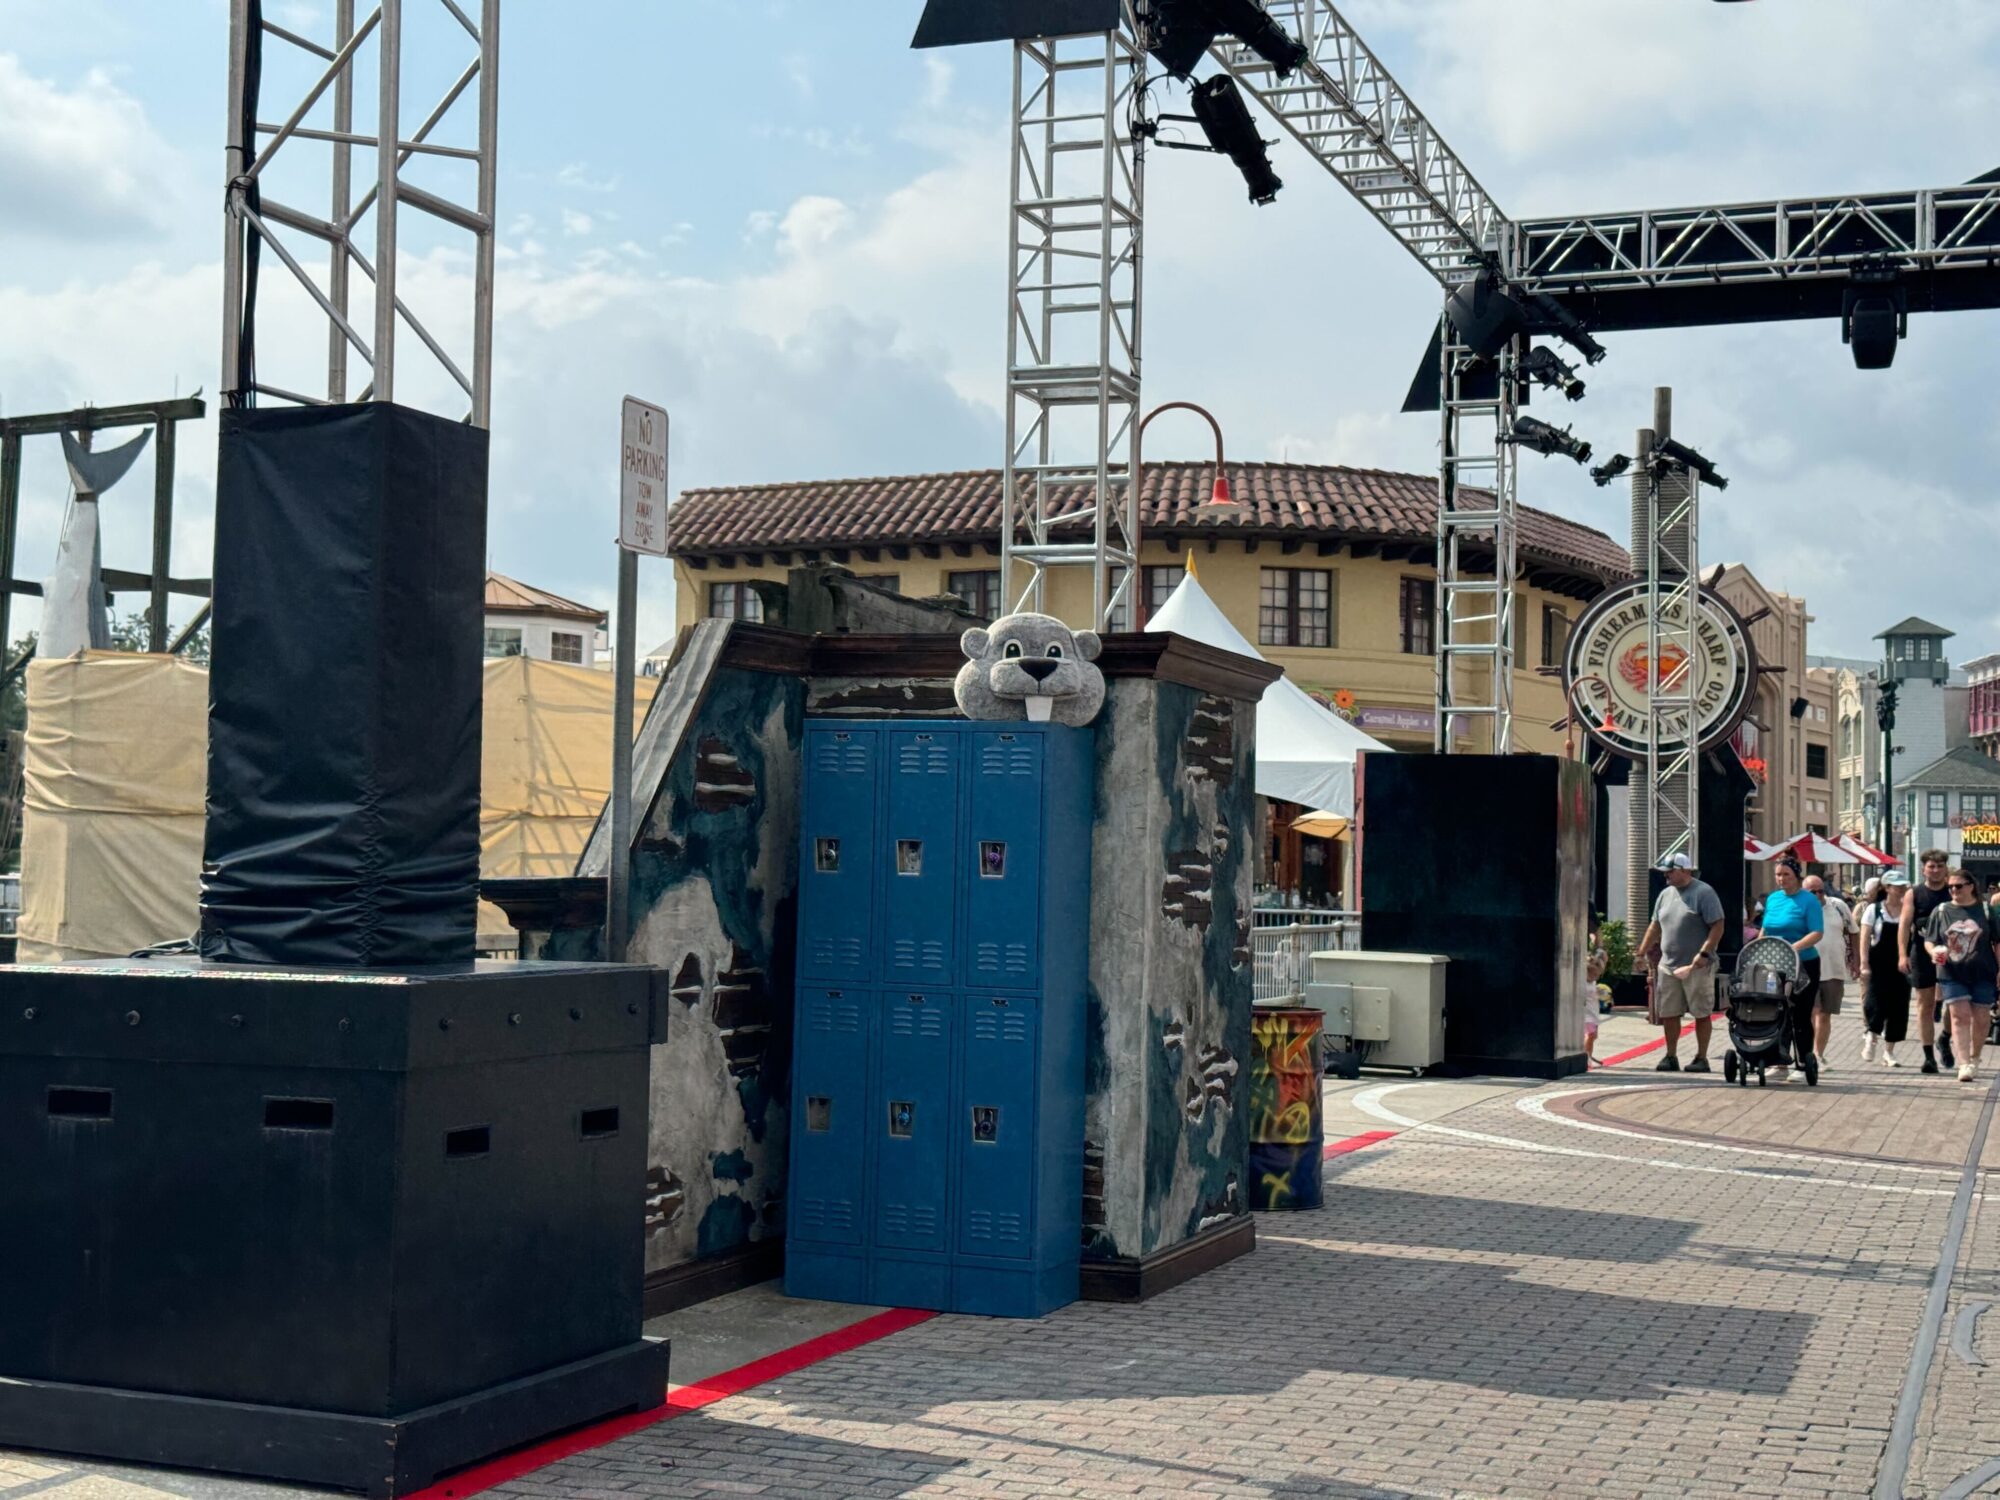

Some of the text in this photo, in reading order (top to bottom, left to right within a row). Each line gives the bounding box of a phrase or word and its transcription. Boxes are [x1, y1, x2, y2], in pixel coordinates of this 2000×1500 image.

[638, 416, 653, 446] NO
[624, 445, 665, 483] PARKING
[637, 481, 653, 499] TOW
[635, 502, 654, 521] AWAY
[634, 521, 654, 541] ZONE
[1686, 614, 1728, 667] HARF
[1960, 830, 2000, 845] MUSEM
